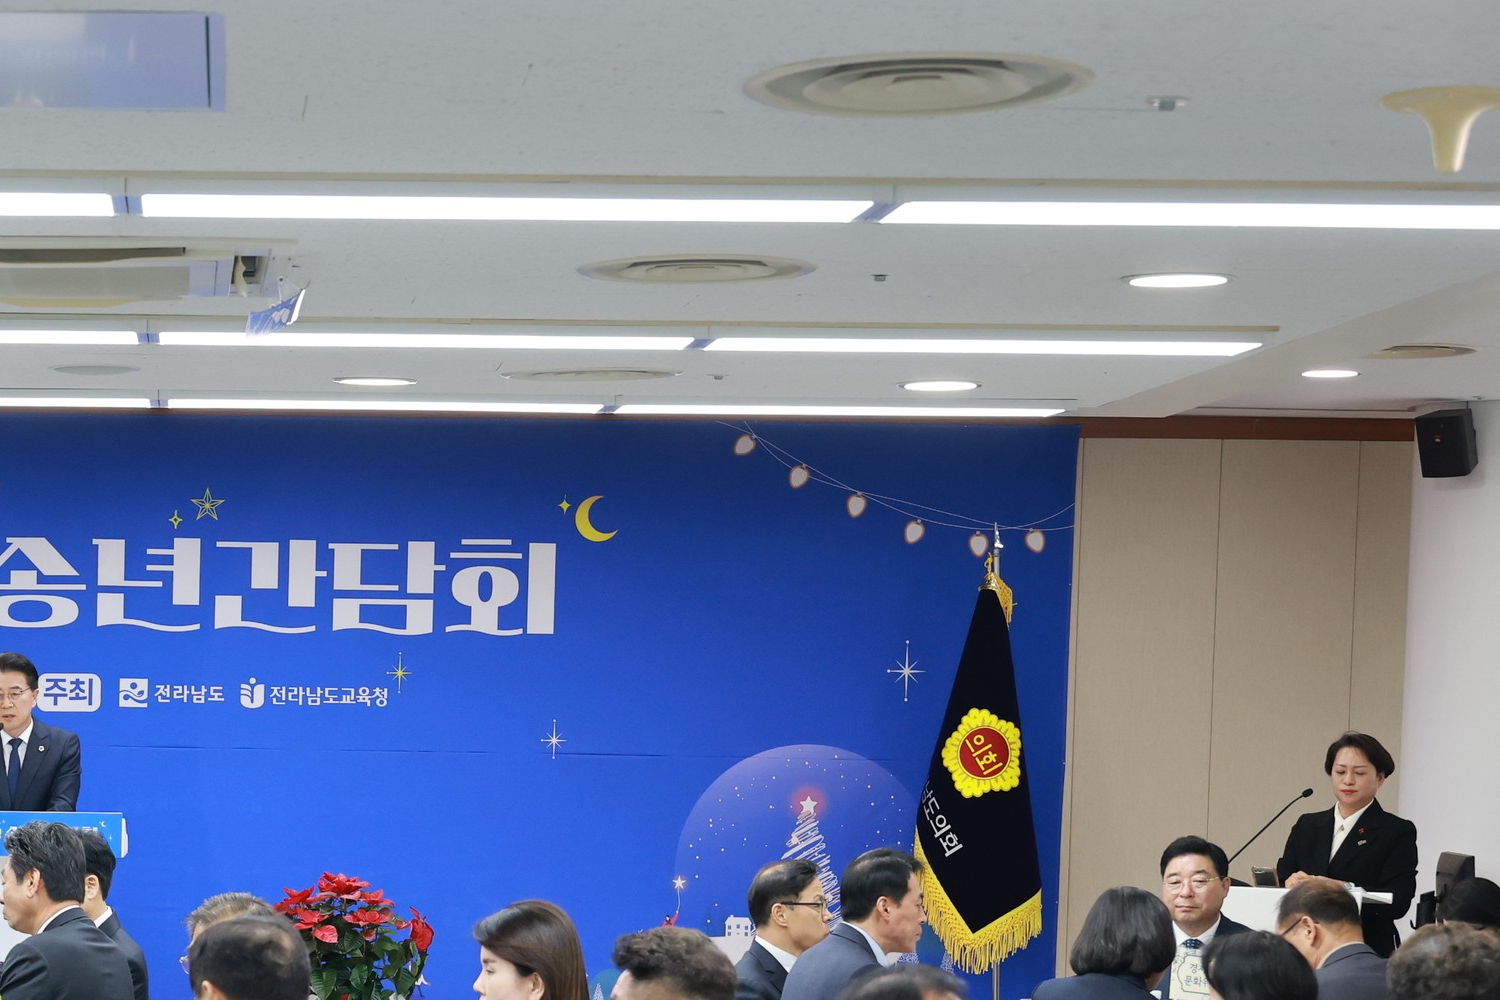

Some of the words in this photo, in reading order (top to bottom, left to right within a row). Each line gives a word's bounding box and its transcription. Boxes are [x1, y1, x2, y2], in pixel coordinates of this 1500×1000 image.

[42, 678, 94, 706] 주최
[154, 683, 225, 704] 전라남도
[269, 685, 389, 708] 전라남도교육청
[965, 734, 1003, 775] 의회
[922, 780, 964, 858] 남도의회
